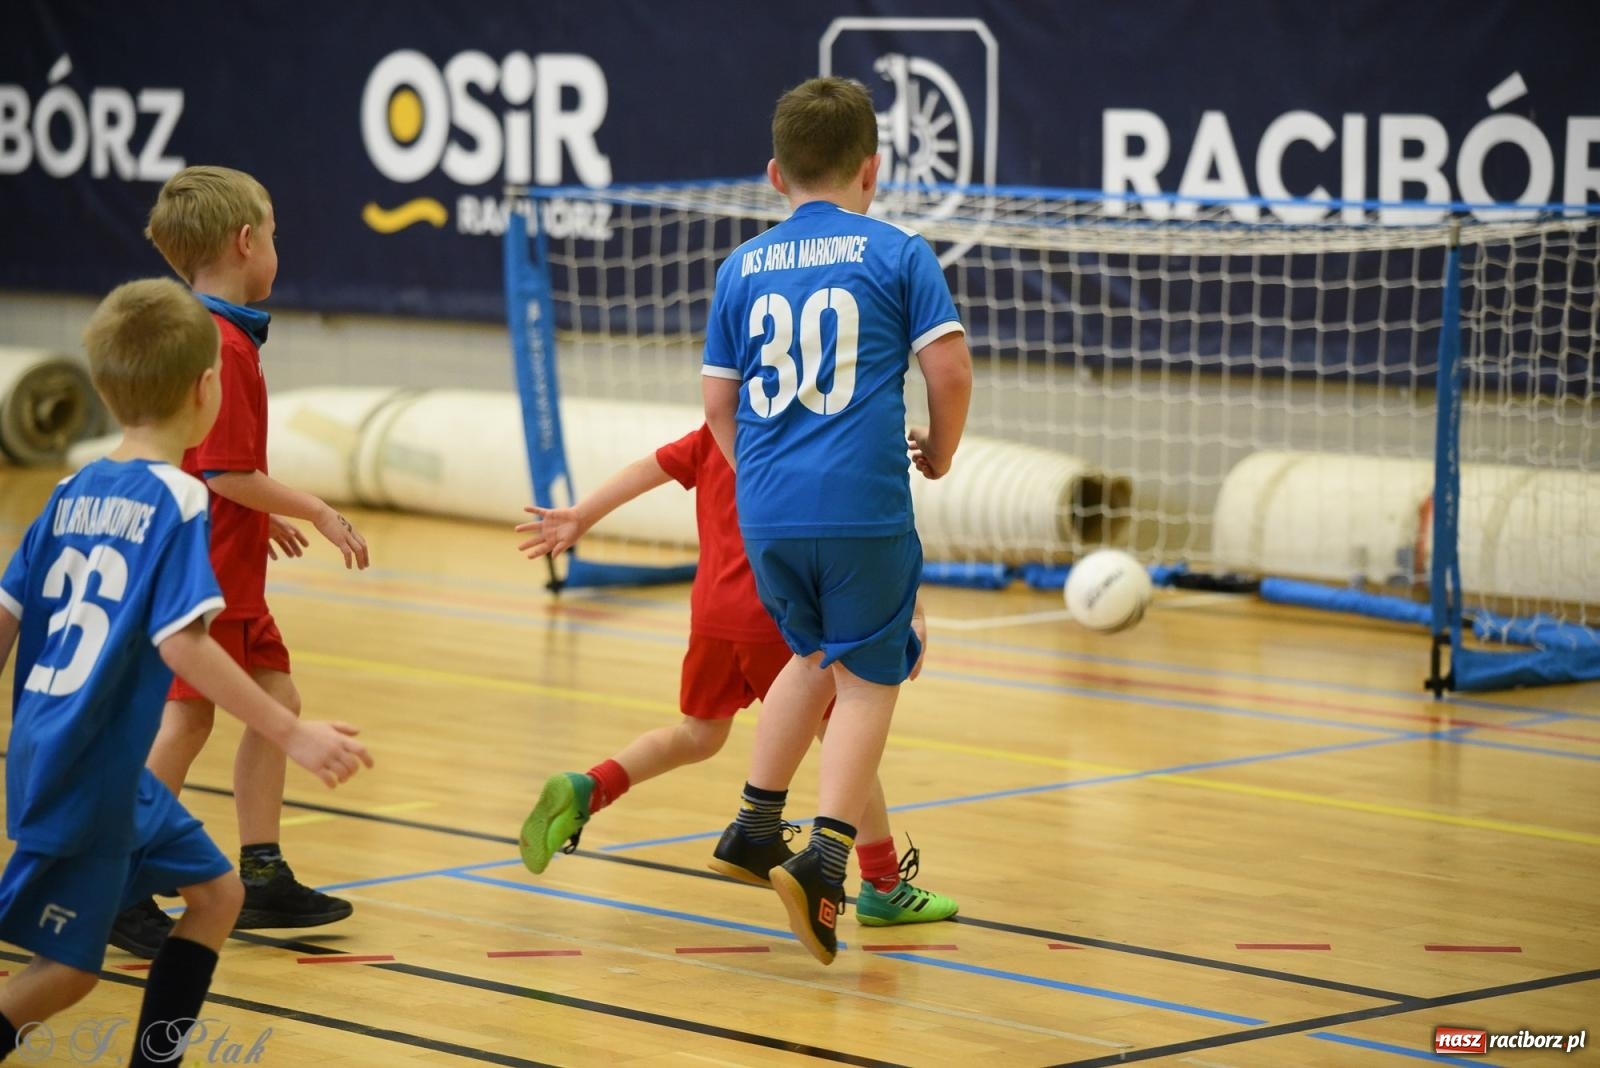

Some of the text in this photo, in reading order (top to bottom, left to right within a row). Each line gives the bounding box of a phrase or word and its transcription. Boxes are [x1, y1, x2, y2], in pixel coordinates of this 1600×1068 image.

[0, 53, 186, 181] BÓRZ
[361, 49, 611, 187] OSiR
[456, 195, 613, 240] RACÓRZ
[741, 235, 868, 277] UKS ARKA MARKOWICE
[748, 288, 860, 418] 30
